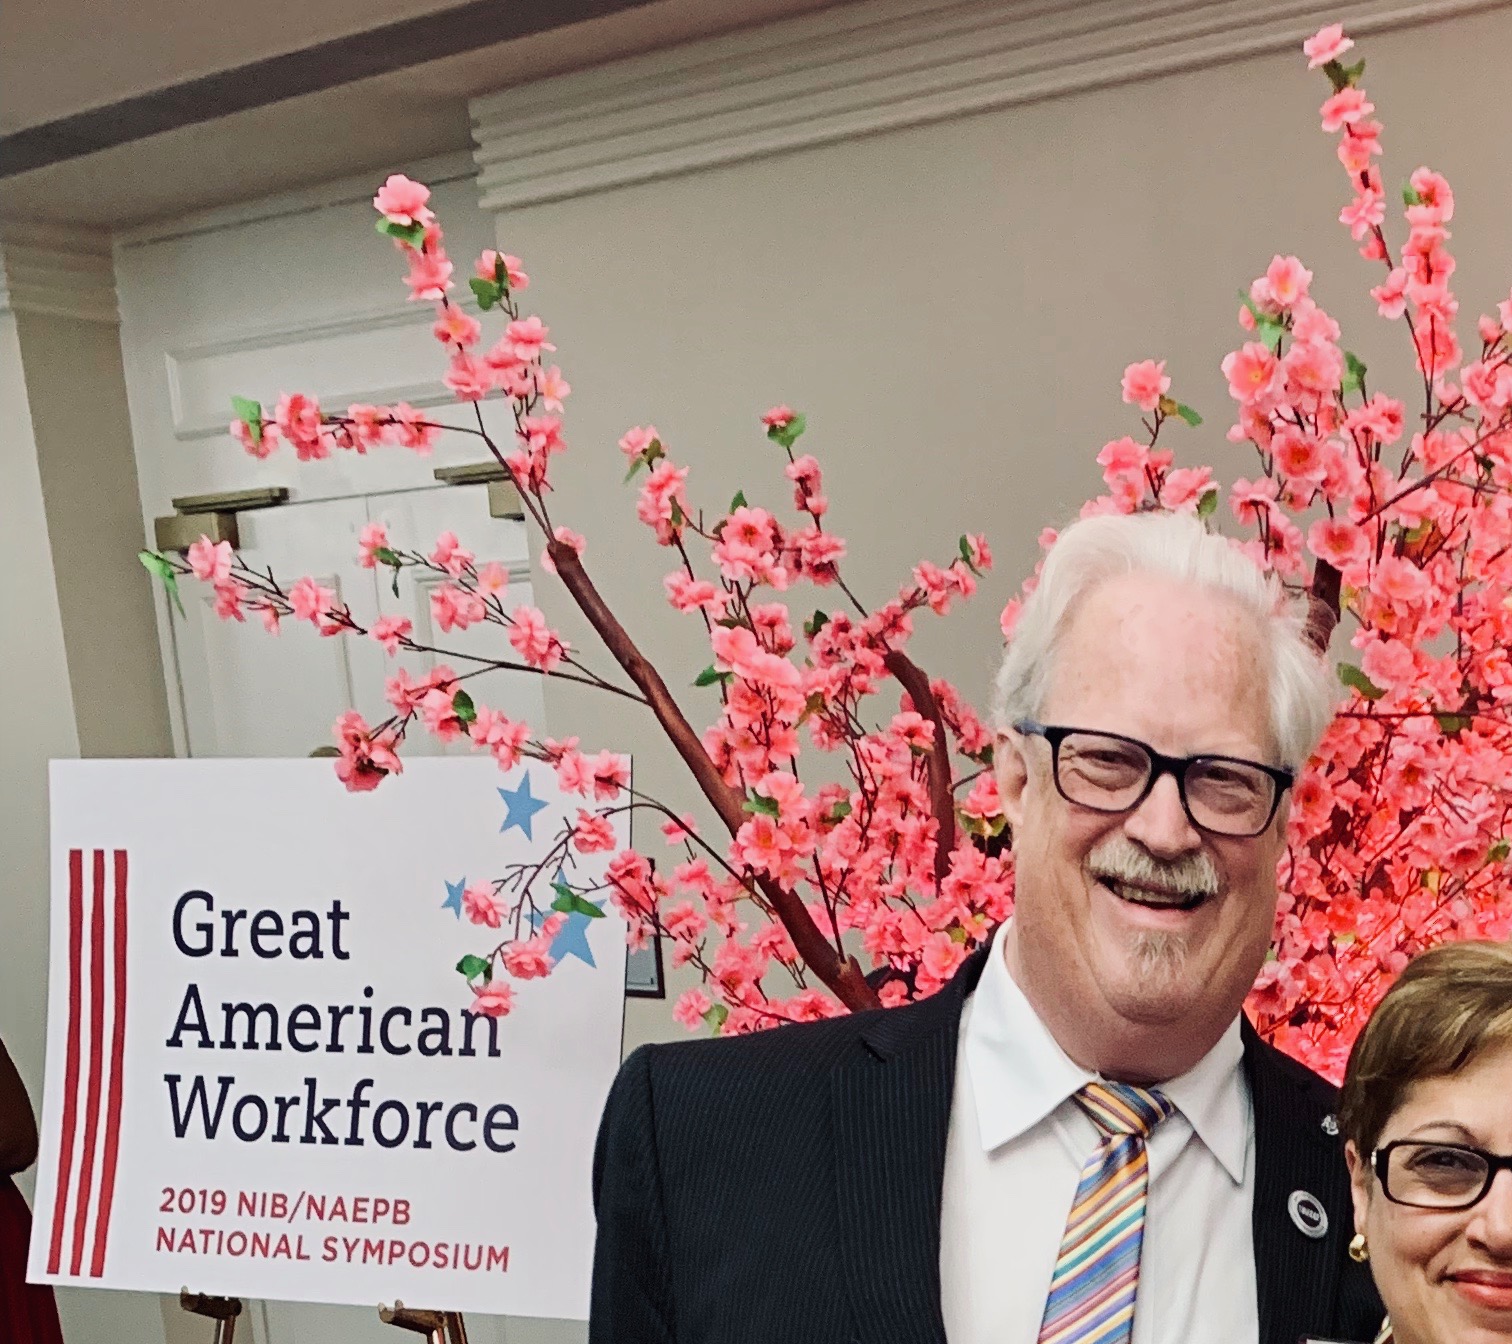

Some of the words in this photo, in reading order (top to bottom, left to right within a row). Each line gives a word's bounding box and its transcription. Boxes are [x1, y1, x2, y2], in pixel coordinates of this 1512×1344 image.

[172, 889, 351, 961] Great
[165, 983, 502, 1058] American
[163, 1073, 520, 1154] Workforce
[158, 1187, 227, 1216] 2019
[236, 1190, 411, 1226] NIB/NAEPB
[155, 1226, 311, 1261] NATIONAL
[321, 1235, 511, 1274] SYMPOSIUM
